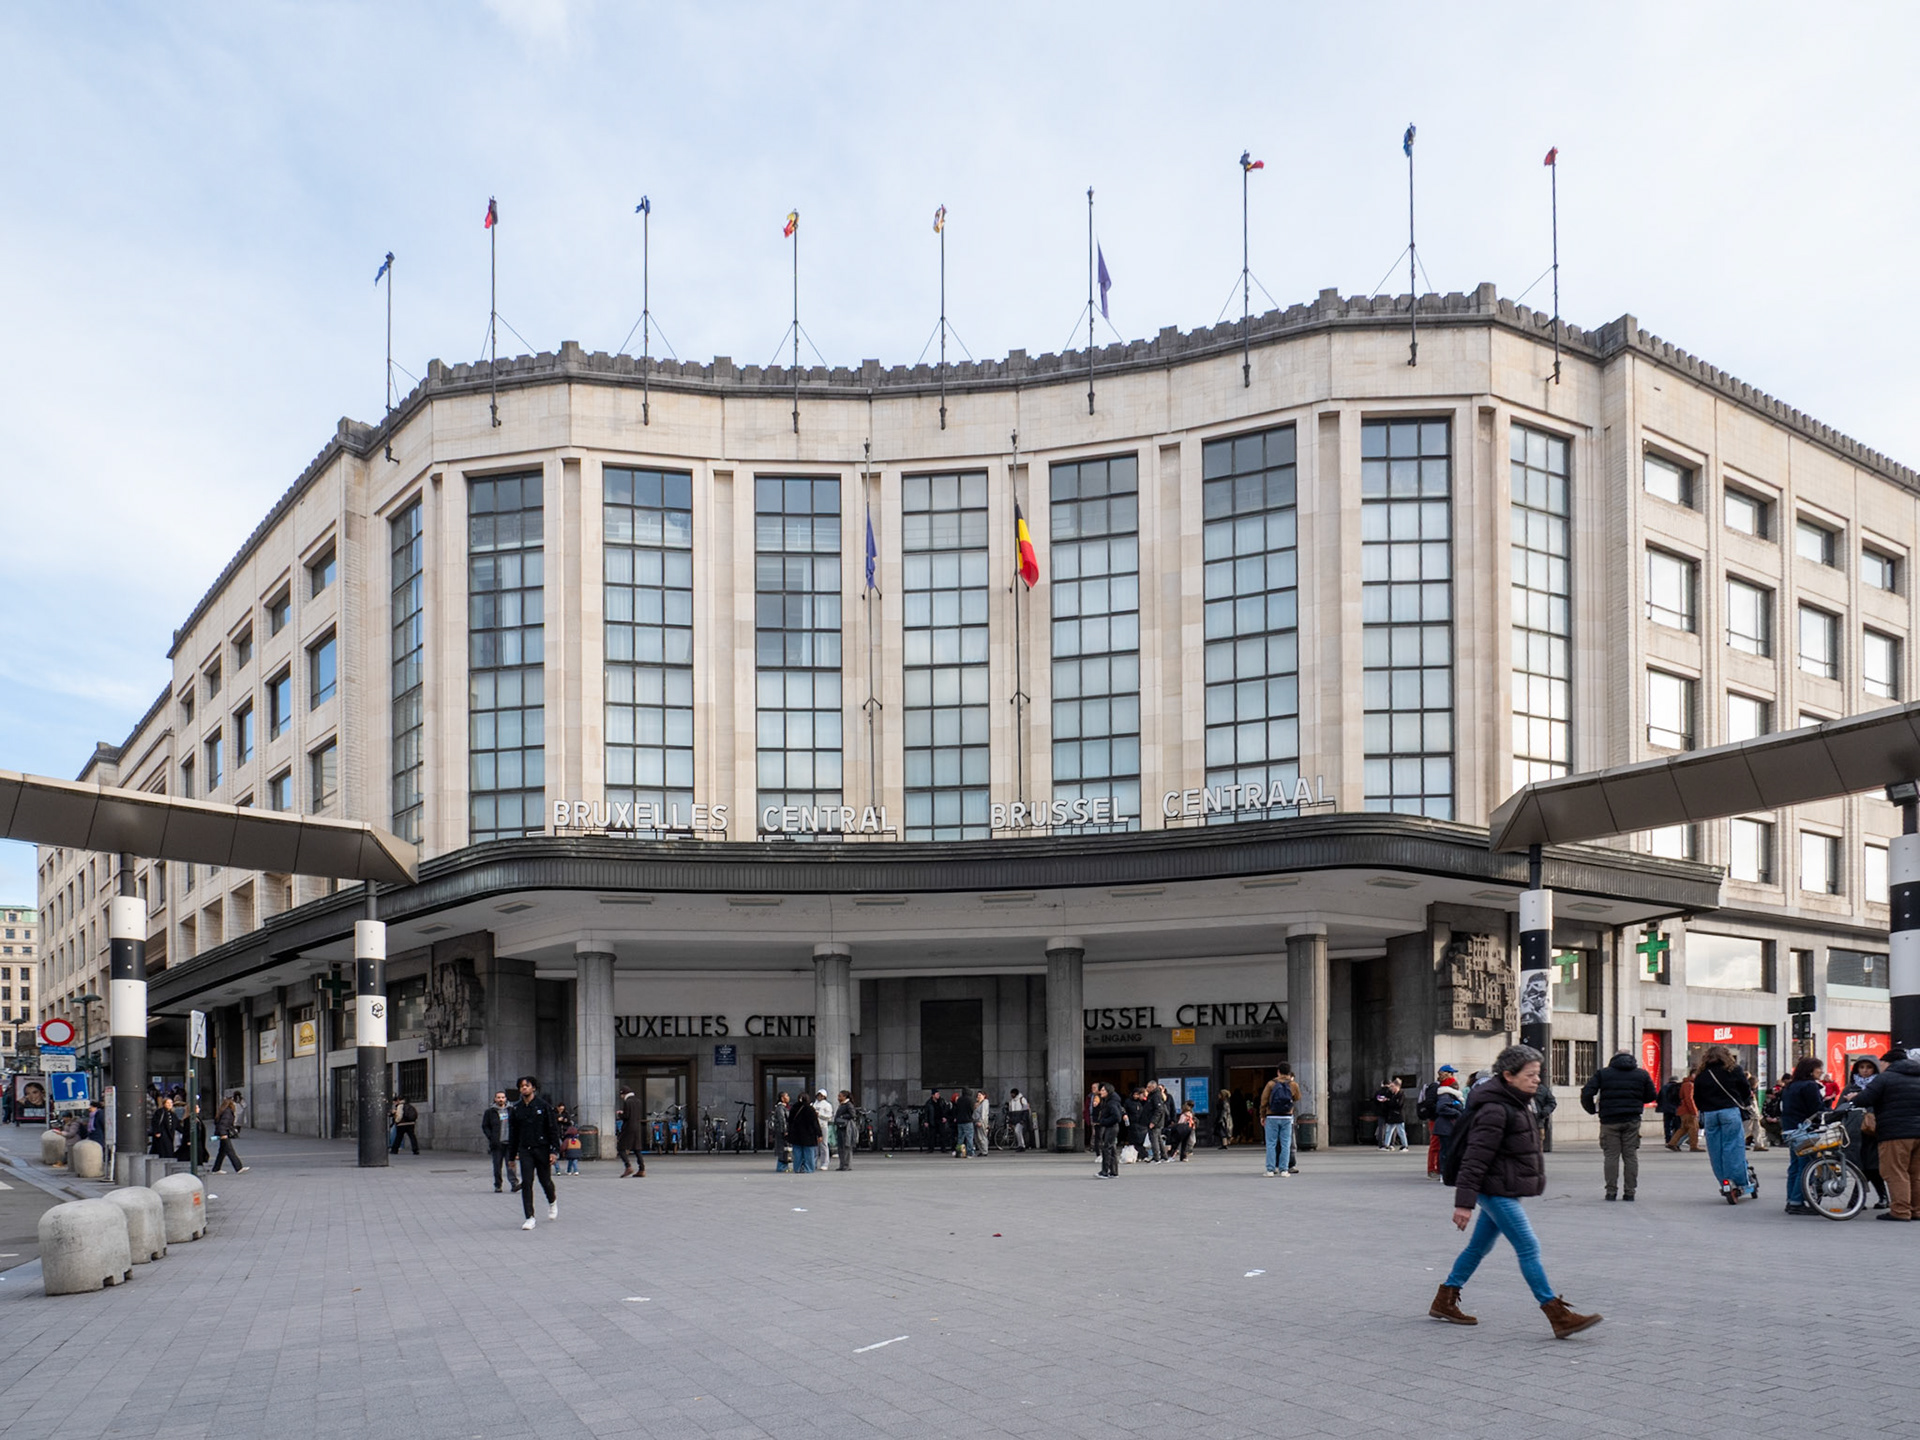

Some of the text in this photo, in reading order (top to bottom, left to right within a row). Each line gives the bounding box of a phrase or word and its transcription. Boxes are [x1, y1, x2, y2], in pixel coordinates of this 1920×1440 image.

[553, 800, 898, 833] BRUXELLES CENTRAL
[990, 775, 1336, 829] BRUSSEL CENTRAAL
[614, 1014, 816, 1037] RUXELLES CENTR
[1083, 1002, 1285, 1030] USSEL CENTRA
